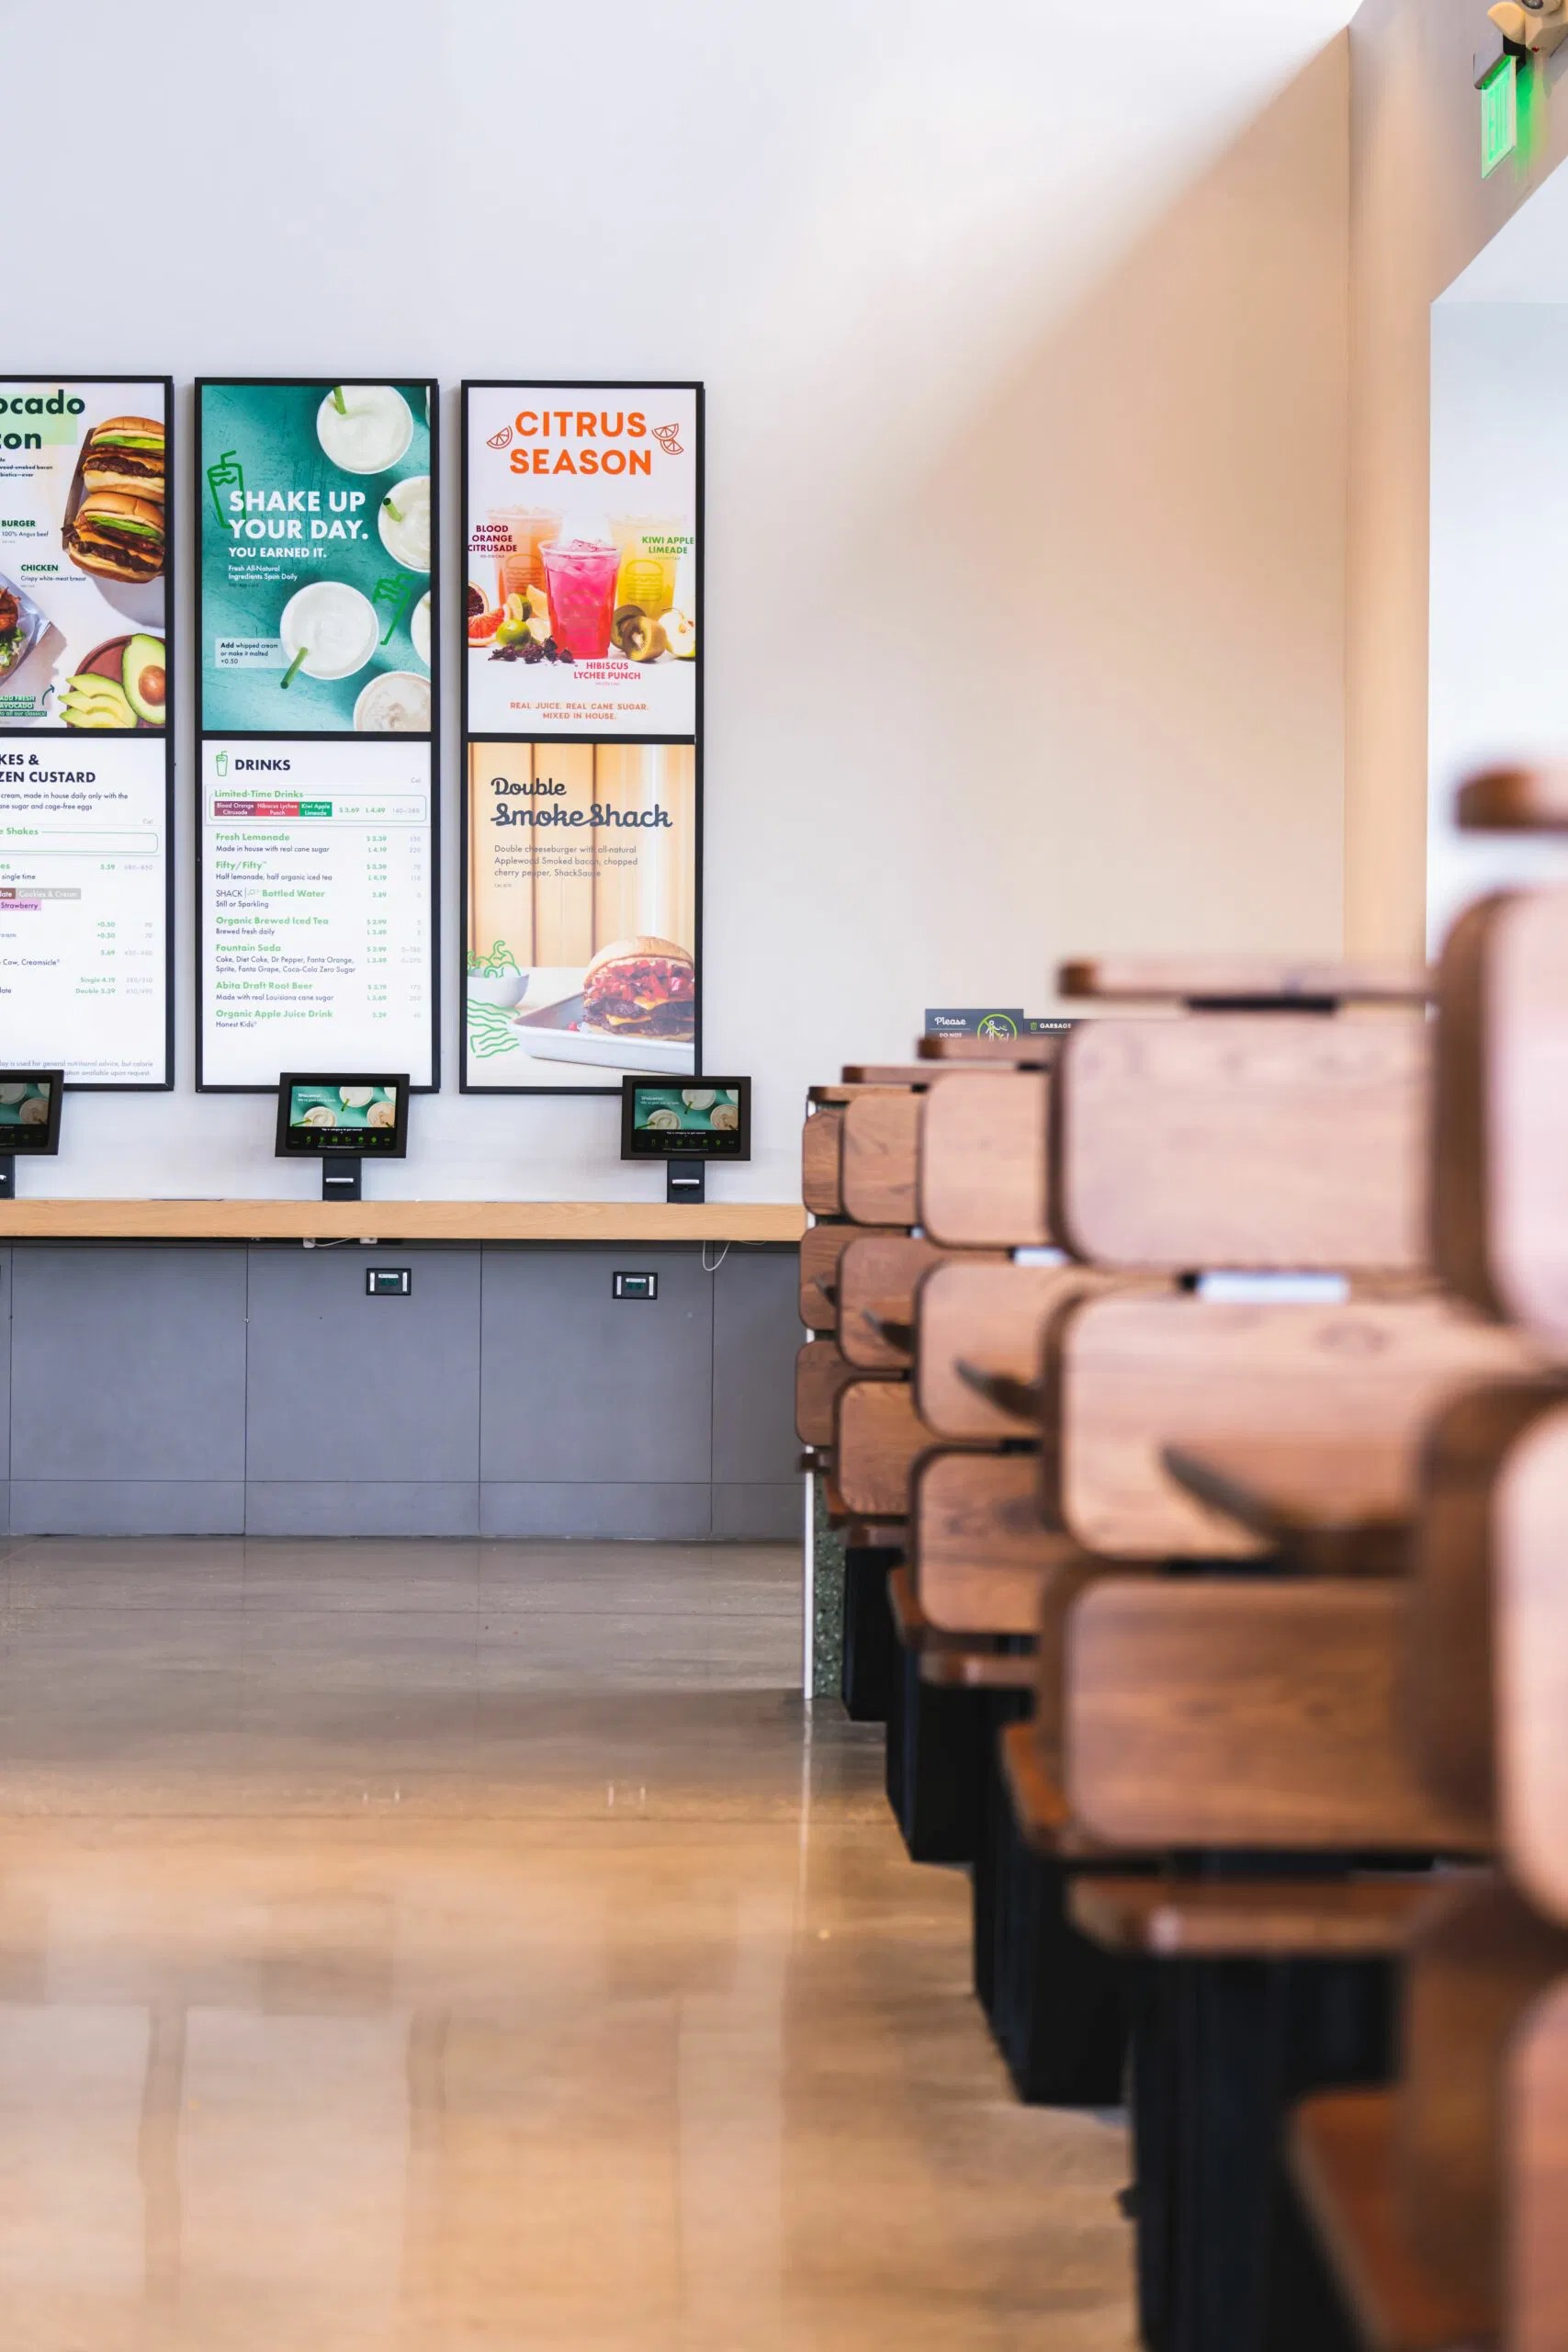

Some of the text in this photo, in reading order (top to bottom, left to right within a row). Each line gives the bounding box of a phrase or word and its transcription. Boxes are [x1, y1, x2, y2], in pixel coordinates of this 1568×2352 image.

[514, 412, 647, 437] CITRUS
[0, 433, 42, 450] on
[510, 449, 651, 475] SEASON
[230, 491, 366, 512] SHAKE UP
[229, 519, 368, 539] YOUR DAY.
[476, 525, 508, 533] BLOOD
[667, 537, 694, 545] APPLE
[229, 548, 327, 558] YOU EARNED IT.
[649, 546, 688, 554] LIMEADE
[573, 672, 605, 680] LYCHEE
[0, 753, 39, 765] KES &
[235, 759, 290, 771] DRINKS
[29, 772, 96, 783] CUSTARD
[491, 777, 567, 796] Double
[72, 792, 86, 801] daily
[88, 792, 102, 801] only
[275, 790, 303, 798] Drinks
[7, 827, 39, 835] Shakes
[217, 832, 240, 841] Fresh
[525, 845, 577, 854] cheeseburger
[598, 845, 636, 854] all-natural
[494, 856, 539, 865] Applewood
[575, 857, 601, 865] bacon,
[604, 857, 637, 866] chopped
[494, 869, 520, 878] cherry
[297, 889, 325, 898] Water
[238, 900, 268, 909] Sparkling
[216, 917, 252, 925] Organic
[259, 928, 275, 936] daily
[216, 944, 255, 952] Fountain
[216, 966, 236, 974] Sprite,
[216, 1010, 252, 1019] Organic
[254, 1010, 281, 1019] Apple
[934, 1017, 966, 1025] Please
